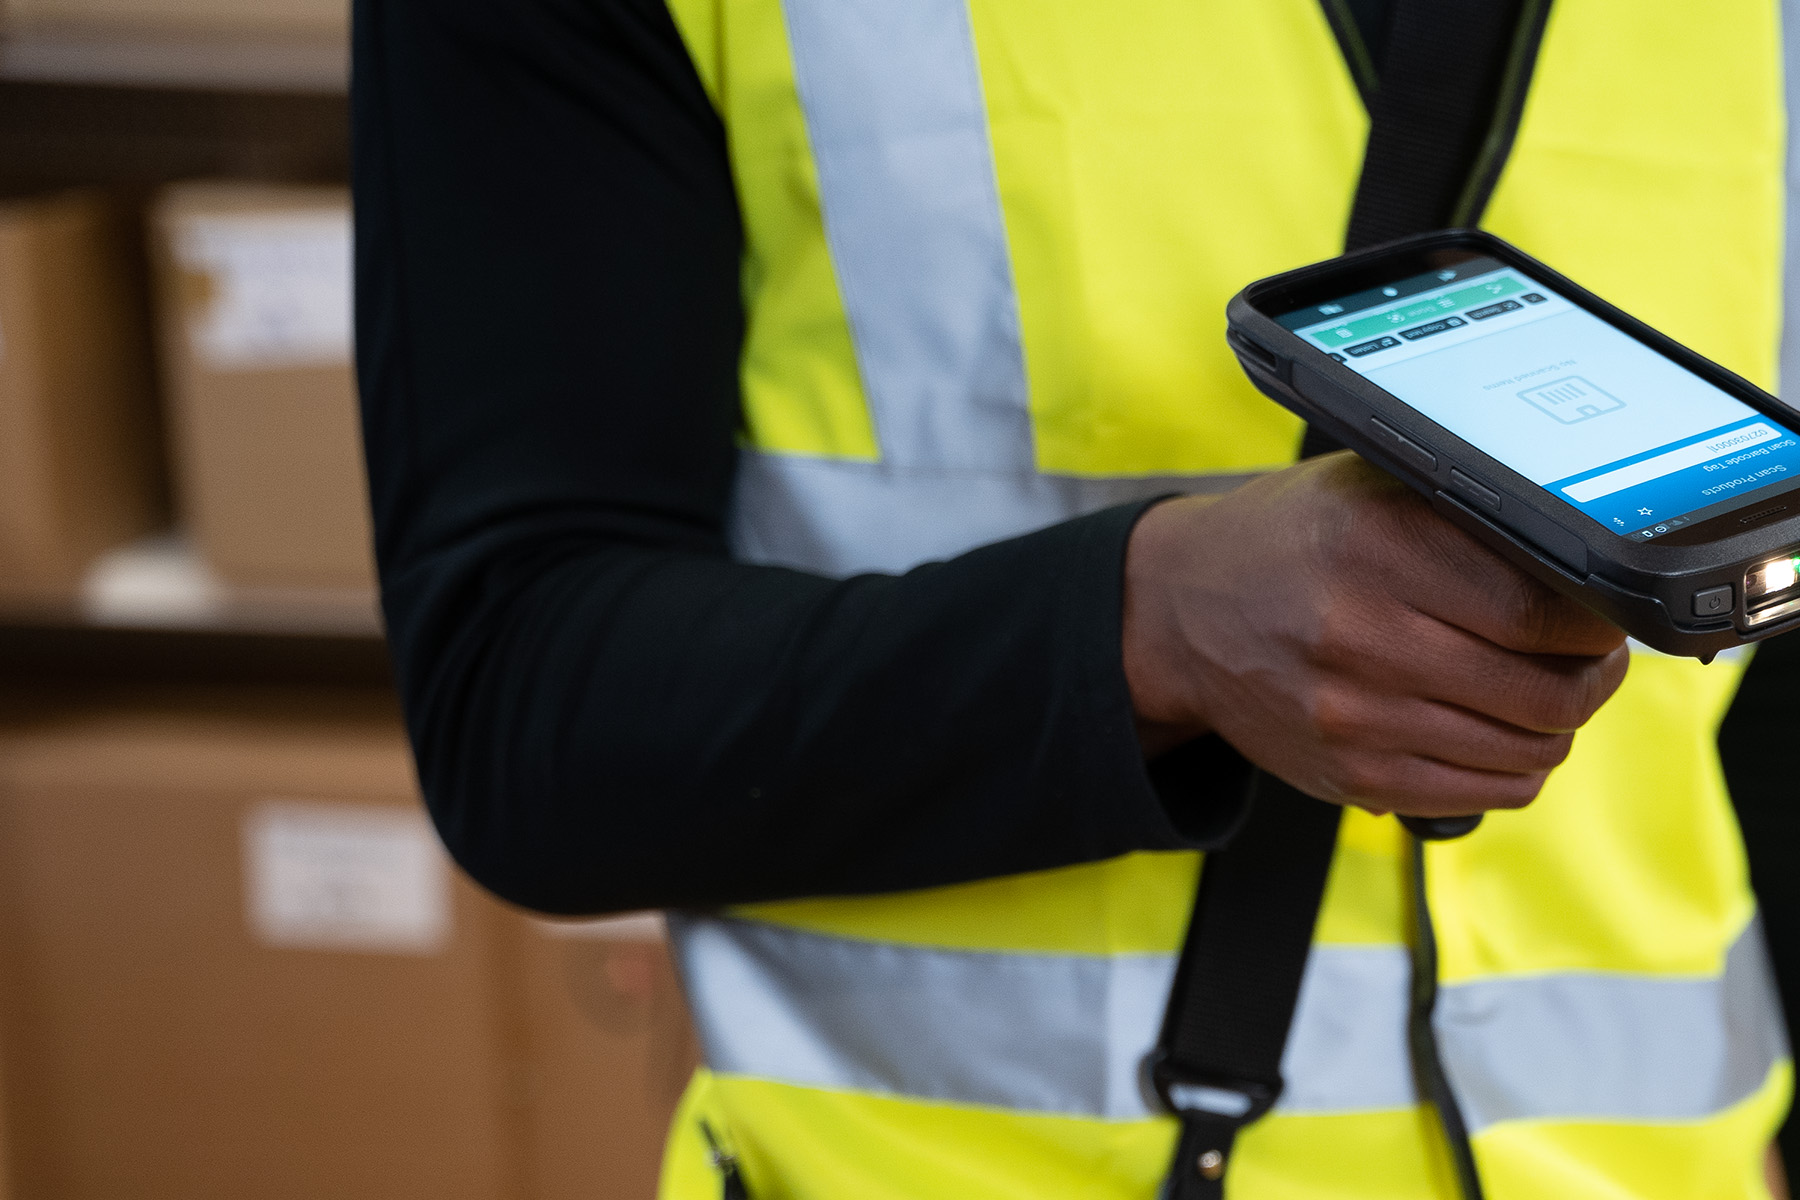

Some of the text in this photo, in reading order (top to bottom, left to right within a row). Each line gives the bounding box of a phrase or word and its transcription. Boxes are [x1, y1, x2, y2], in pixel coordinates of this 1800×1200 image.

[1514, 365, 1560, 382] Scanned
[1702, 438, 1796, 473] Scan Barcode Tag
[1701, 463, 1787, 498] Scan Products
